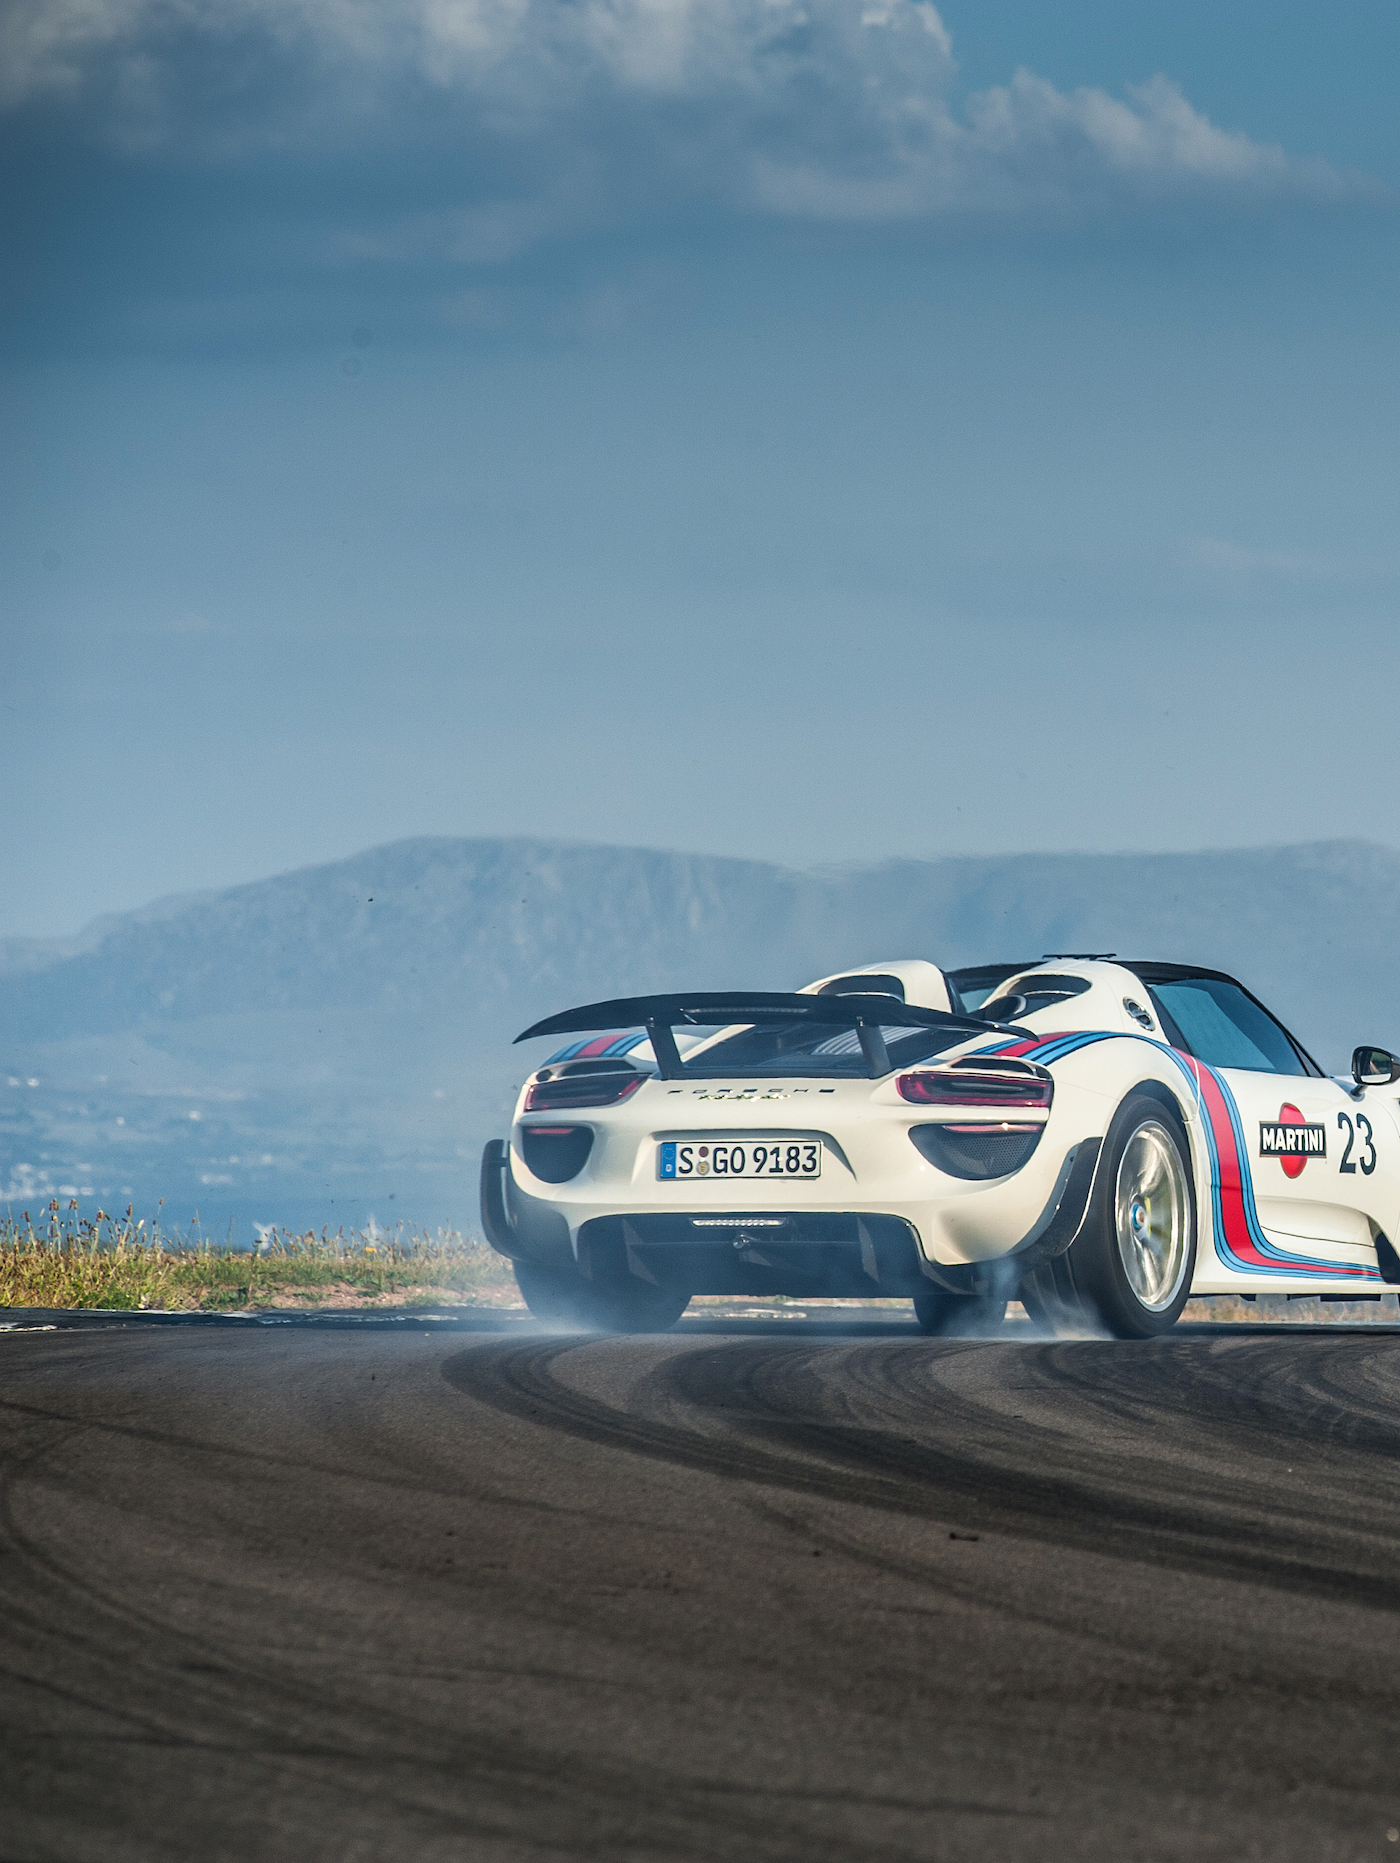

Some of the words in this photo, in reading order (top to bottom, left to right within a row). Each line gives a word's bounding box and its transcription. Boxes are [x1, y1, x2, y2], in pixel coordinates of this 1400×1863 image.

[1262, 1127, 1324, 1152] MARTINI
[1337, 1111, 1377, 1175] 23
[678, 1147, 694, 1174] S
[712, 1146, 746, 1174] GO
[753, 1146, 817, 1173] 9183
